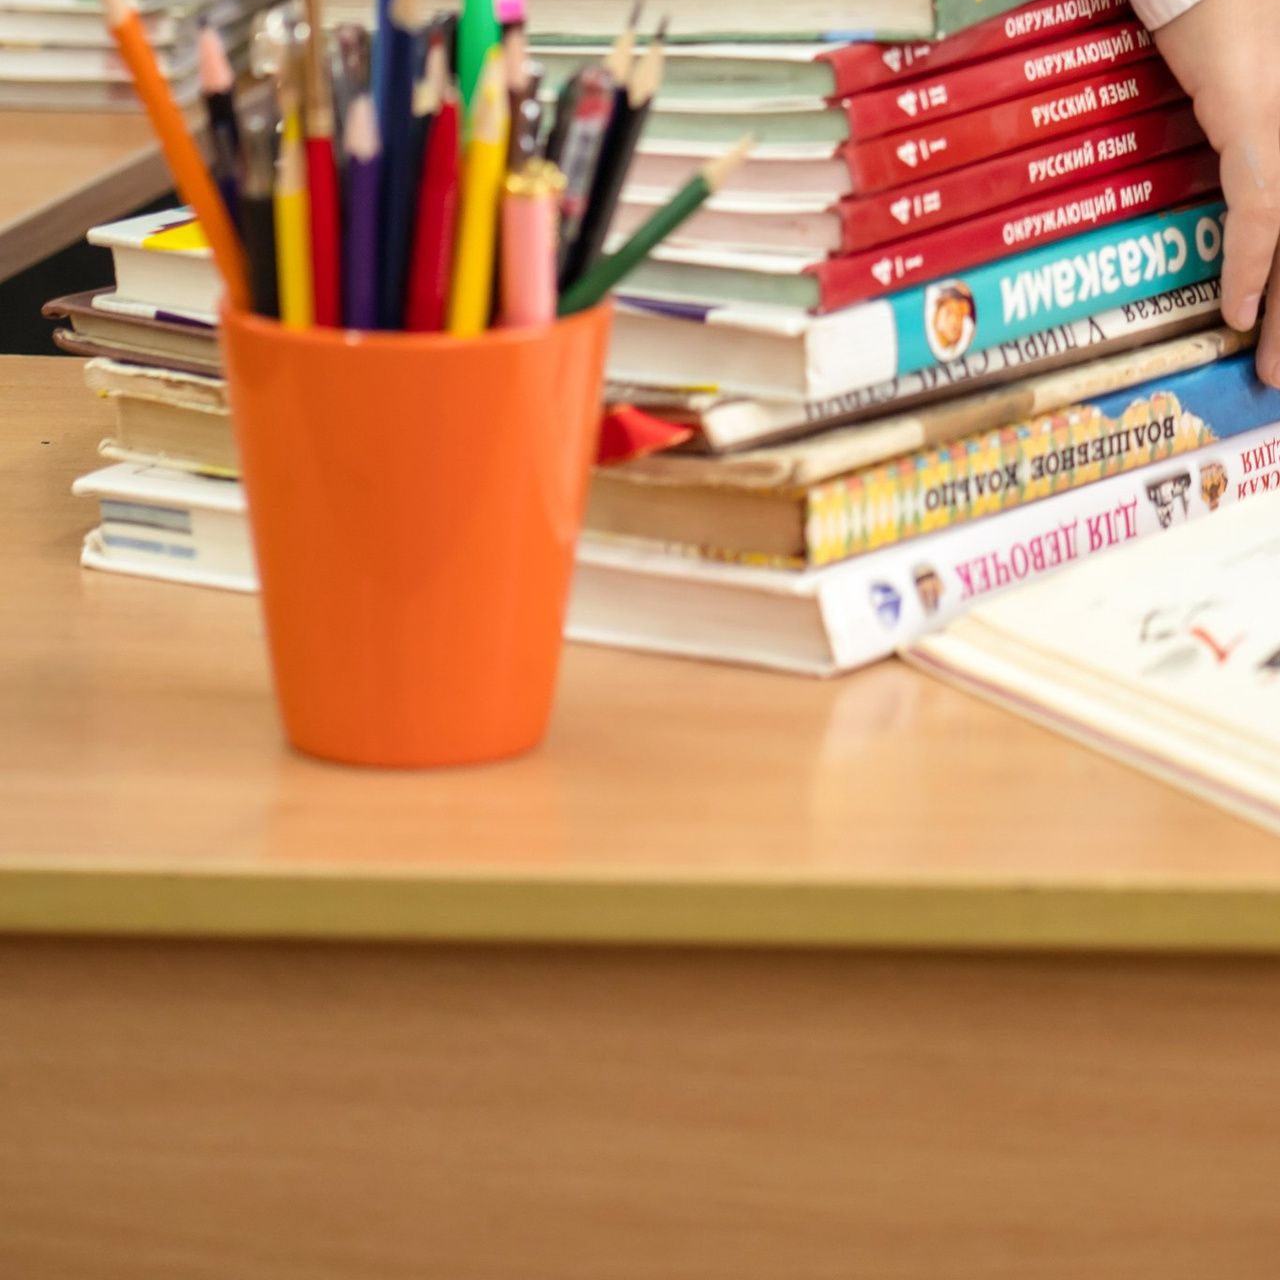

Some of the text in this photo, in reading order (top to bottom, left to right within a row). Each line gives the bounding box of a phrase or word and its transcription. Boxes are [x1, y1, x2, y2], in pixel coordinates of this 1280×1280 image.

[1024, 29, 1134, 82] ОКРУЖАЮЩИЙ
[1031, 78, 1139, 128] РУССКИЙ ЯЗЫК
[1028, 131, 1137, 184] РУССКИЙ ЯЗЫК
[1002, 180, 1153, 246] ОКРУЖАЮЩИЙ МИР
[1001, 226, 1188, 326] сказками
[1121, 282, 1223, 324] илевская
[924, 415, 1176, 511] ВОЛШЕБНОЕ КОЛЬЦО
[1086, 495, 1138, 553] ДЛЯ
[954, 516, 1079, 601] ДЕВОЧЕК
